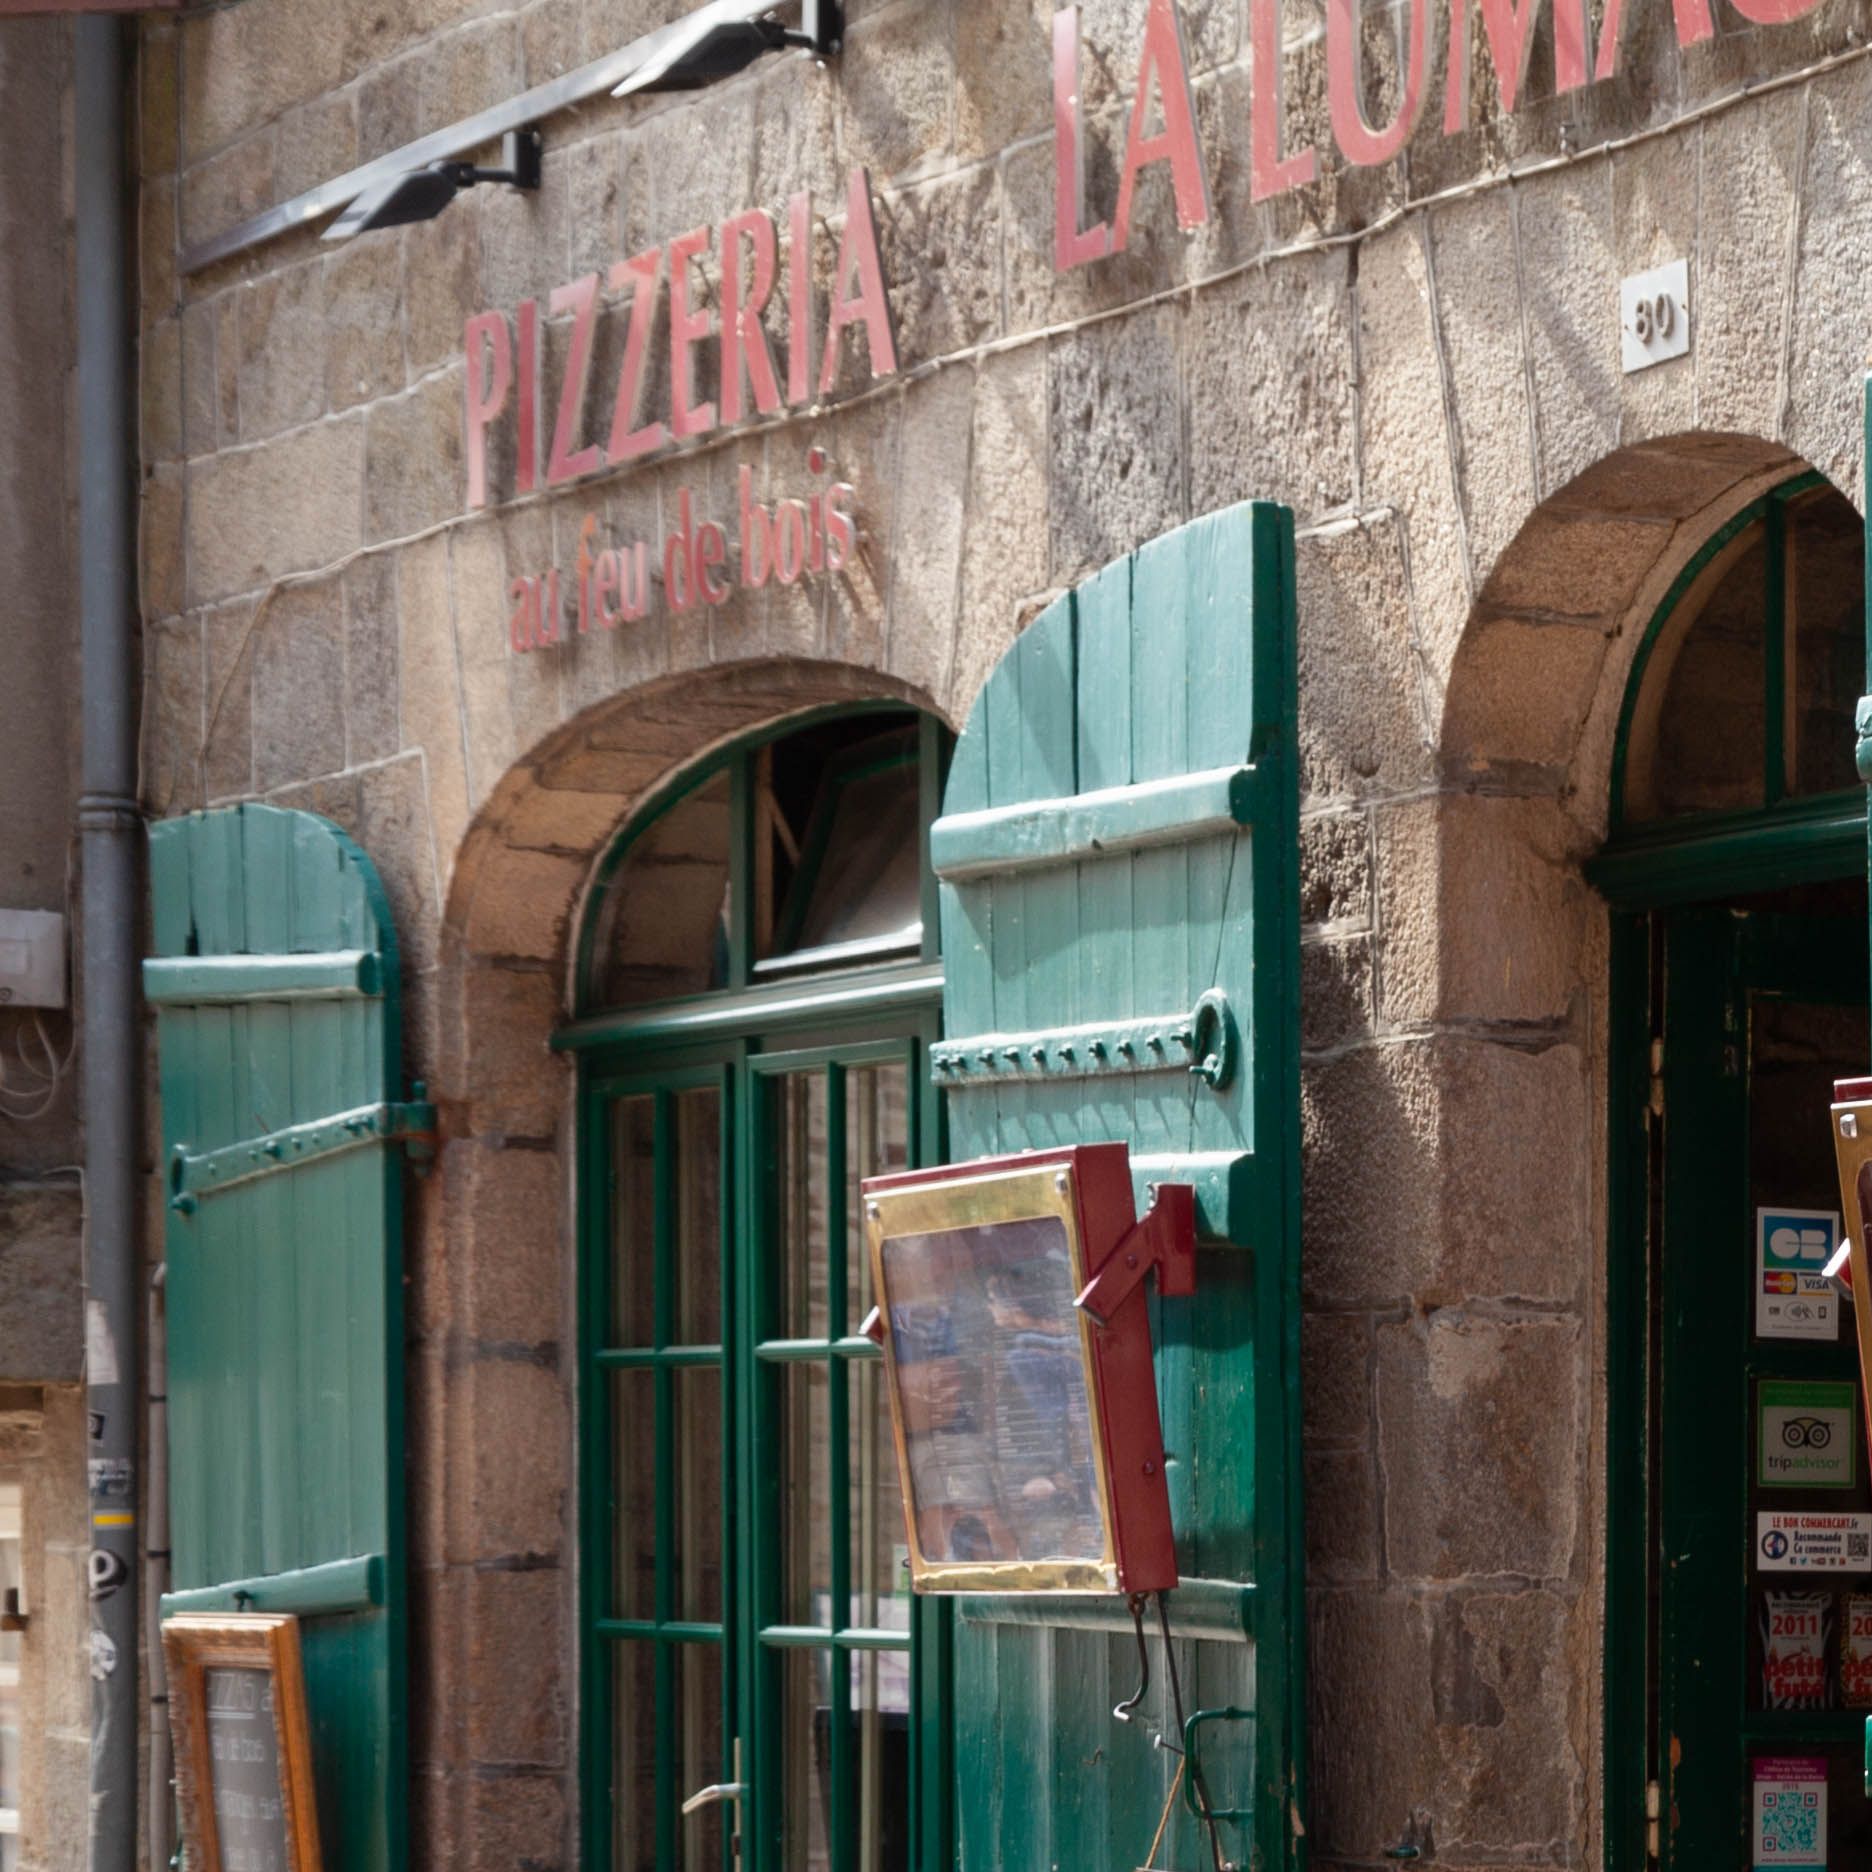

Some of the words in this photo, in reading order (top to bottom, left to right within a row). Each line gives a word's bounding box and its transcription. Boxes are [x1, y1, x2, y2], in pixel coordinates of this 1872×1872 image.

[1054, 4, 1208, 271] LA
[464, 167, 897, 510] PIZZERIA
[509, 575, 560, 653] au
[577, 513, 648, 635] feu
[664, 487, 731, 615] de
[739, 447, 856, 589] bois
[1804, 1279, 1830, 1290] VISA
[1768, 1455, 1841, 1472] tripadvisor
[1772, 1517, 1782, 1528] LE
[1783, 1517, 1798, 1528] BON
[1772, 1615, 1818, 1635] 2011
[1763, 1656, 1824, 1681] petit
